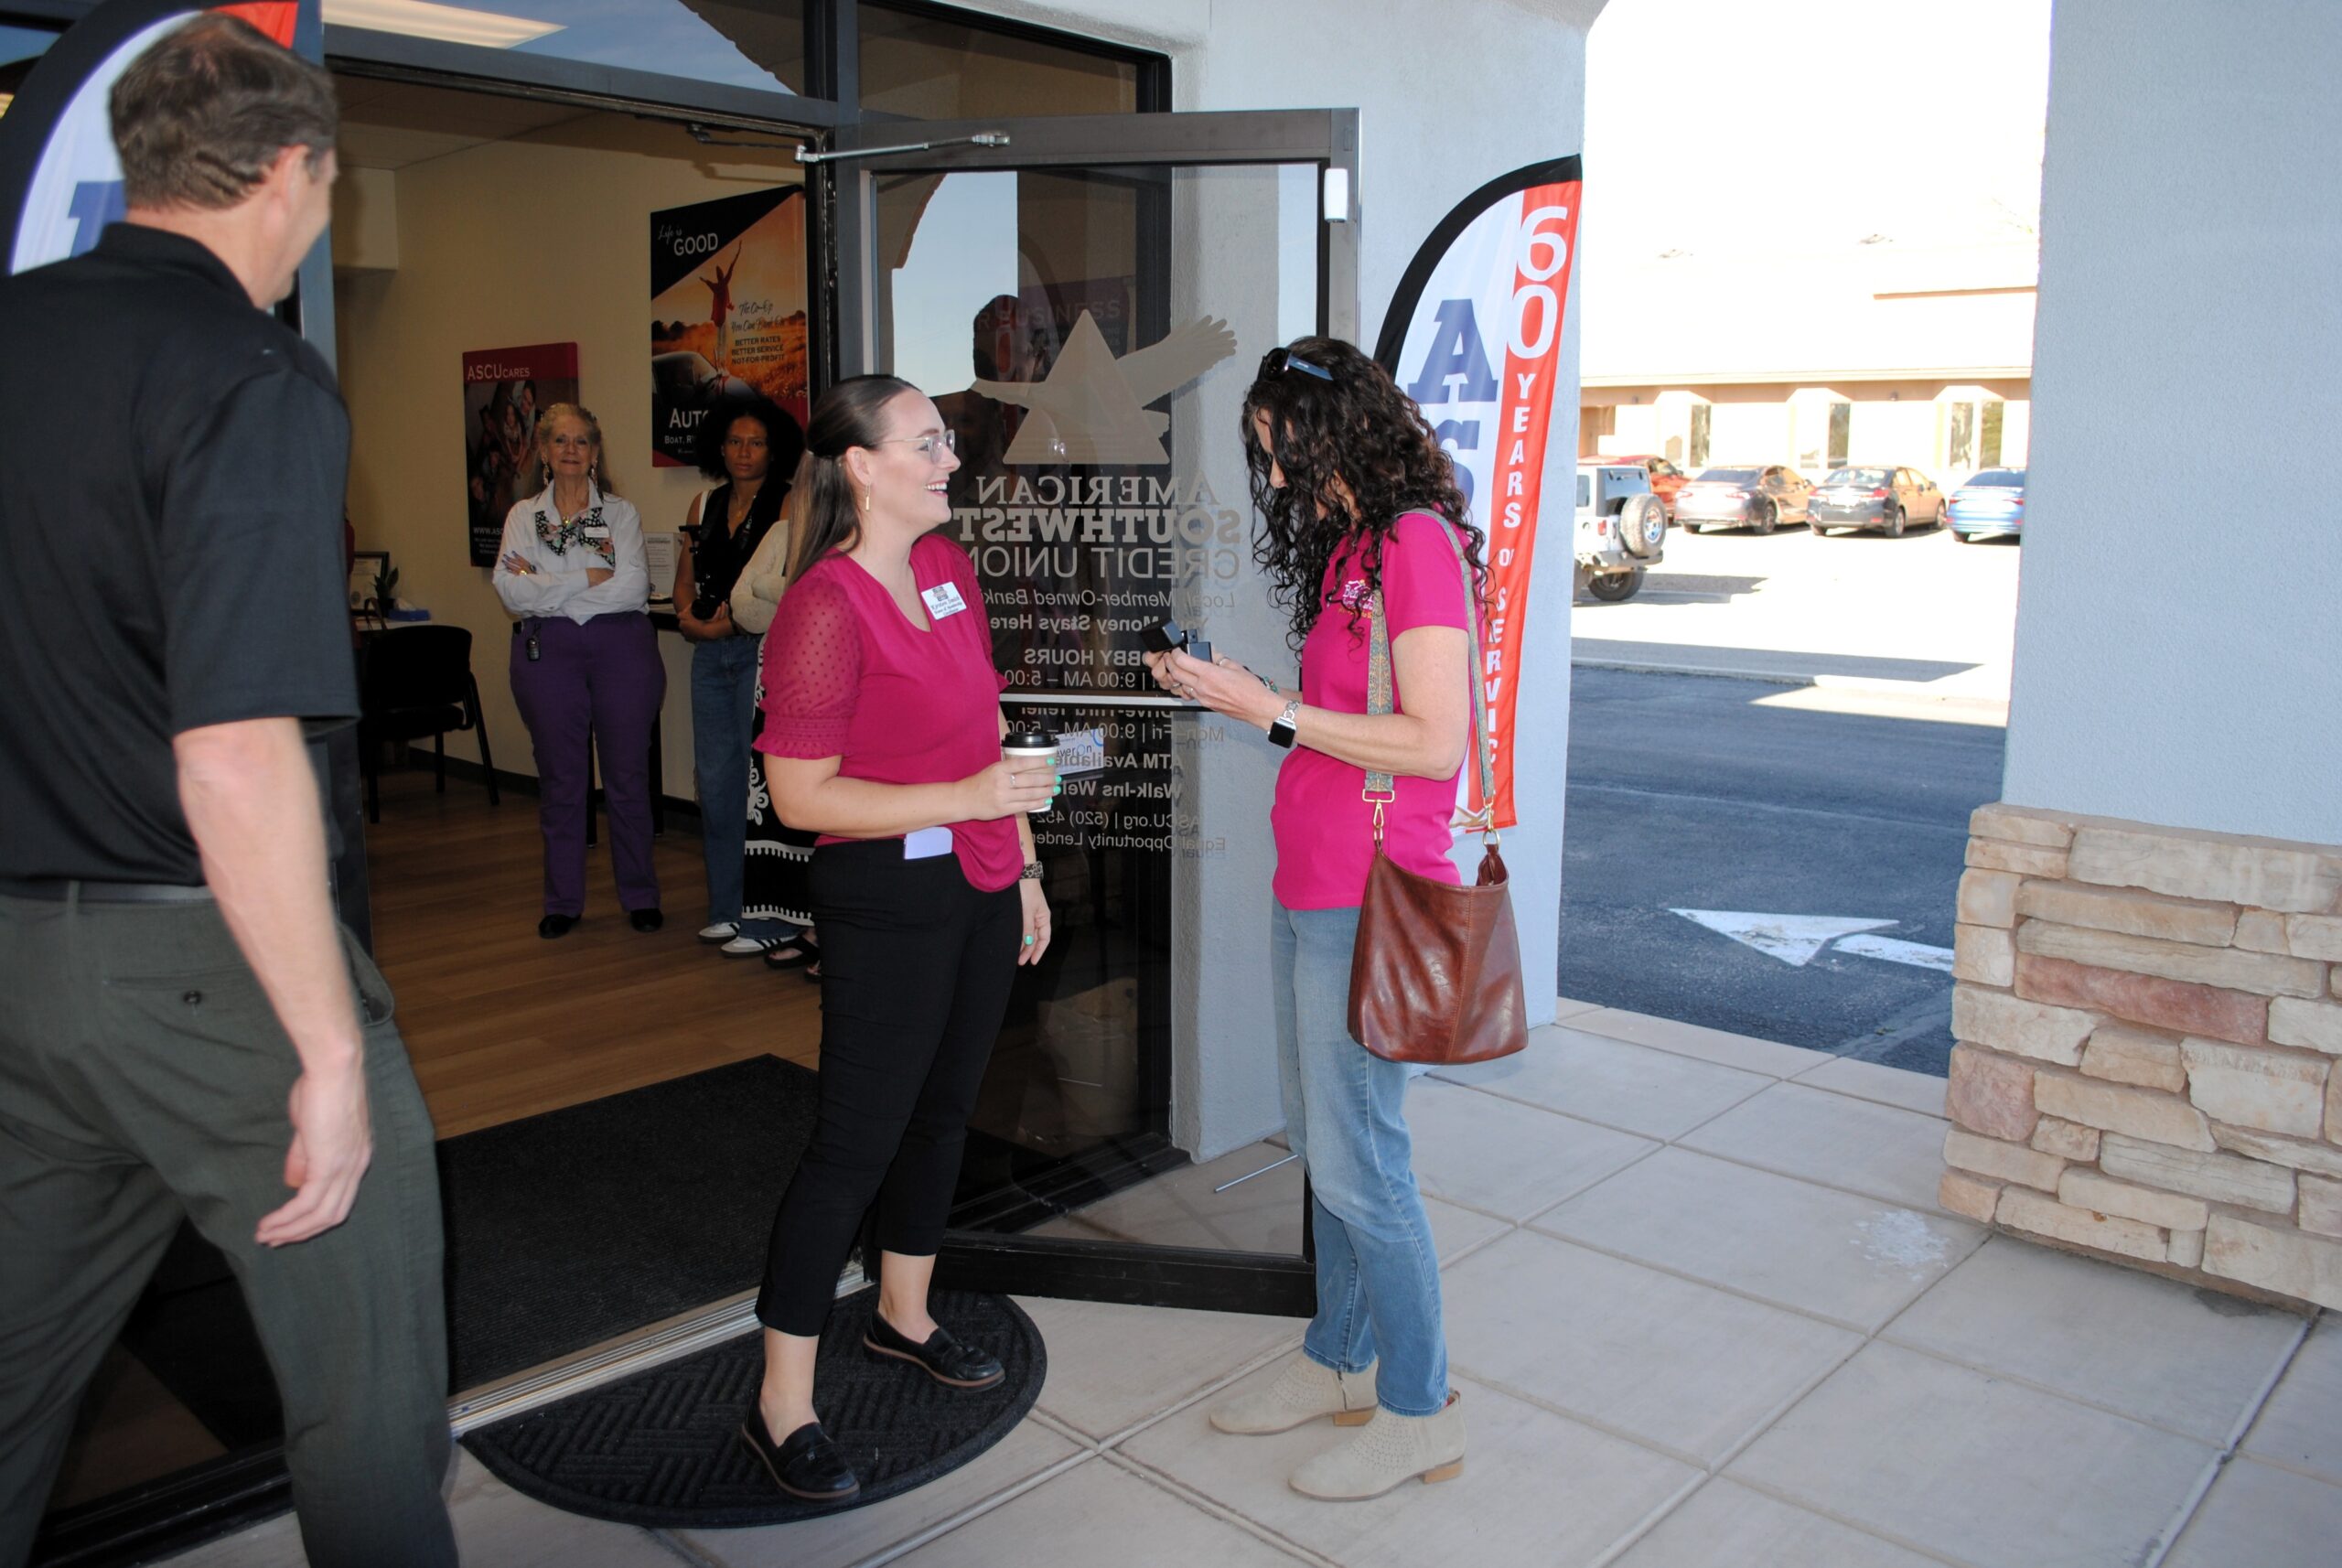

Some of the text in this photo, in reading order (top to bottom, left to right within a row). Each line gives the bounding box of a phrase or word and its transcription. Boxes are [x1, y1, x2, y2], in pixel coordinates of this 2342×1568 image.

[658, 224, 682, 244] Life is
[673, 232, 719, 256] GOOD
[1507, 206, 1568, 360] 60
[732, 344, 783, 356] BETTER SERVICE
[735, 335, 780, 347] BETTER RATES
[732, 354, 784, 365] NOT-FOR-PROFIT
[1503, 373, 1537, 529] YEARS
